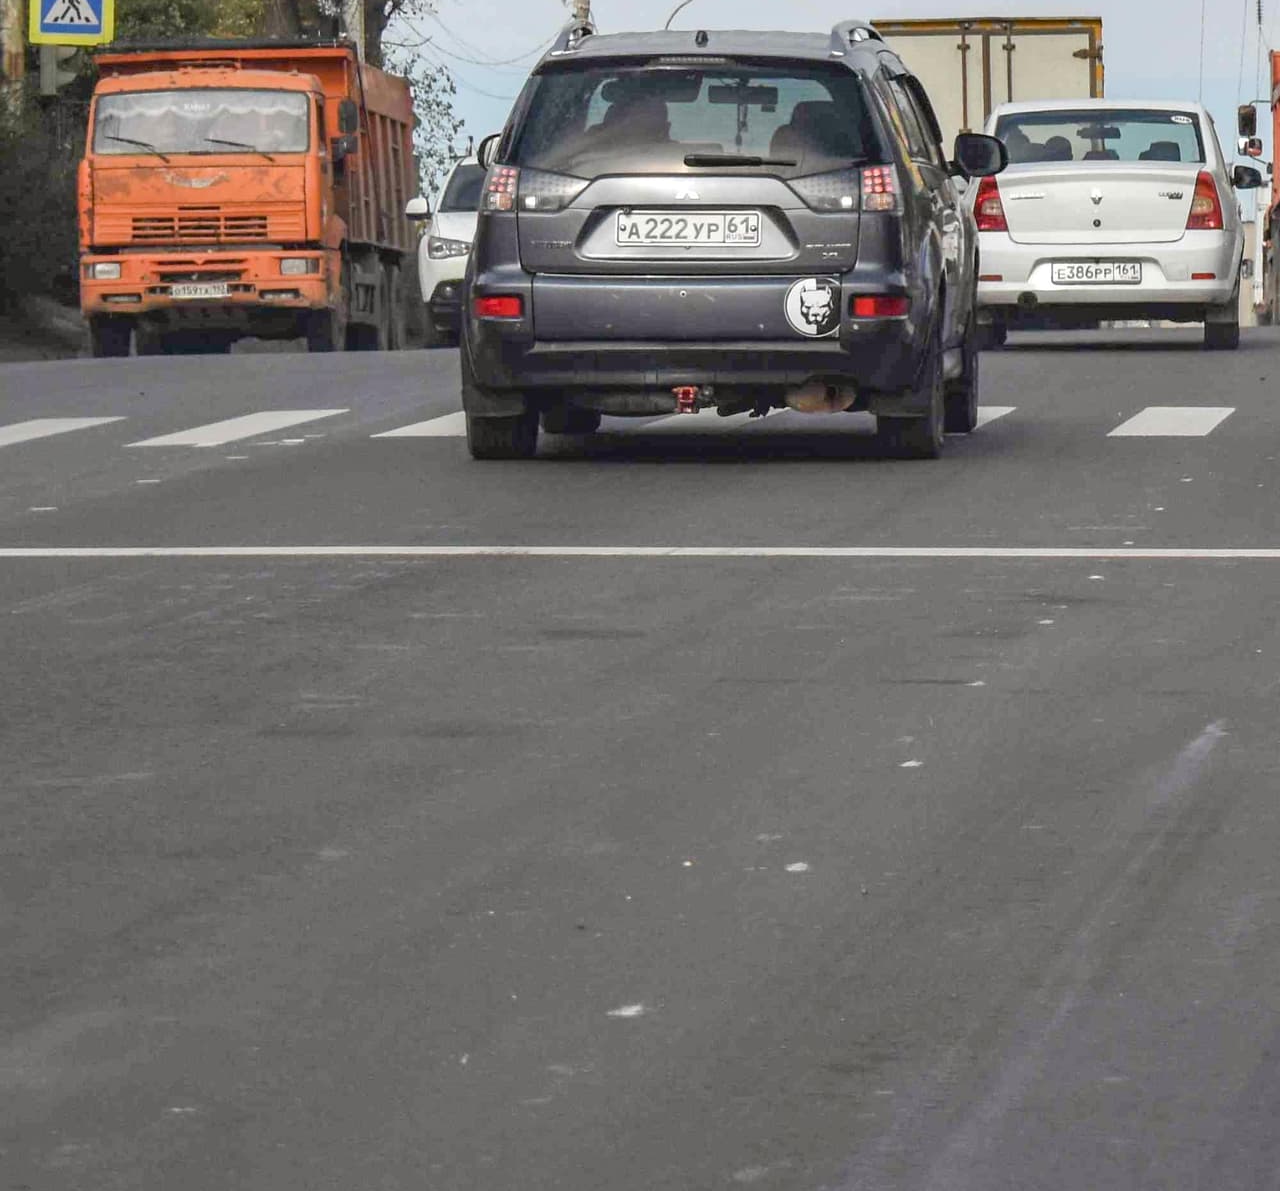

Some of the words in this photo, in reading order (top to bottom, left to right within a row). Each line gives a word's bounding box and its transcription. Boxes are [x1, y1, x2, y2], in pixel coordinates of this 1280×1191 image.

[627, 218, 719, 240] А222УР
[727, 217, 750, 234] 61
[1057, 265, 1112, 280] Е386РР
[1115, 264, 1136, 275] 161
